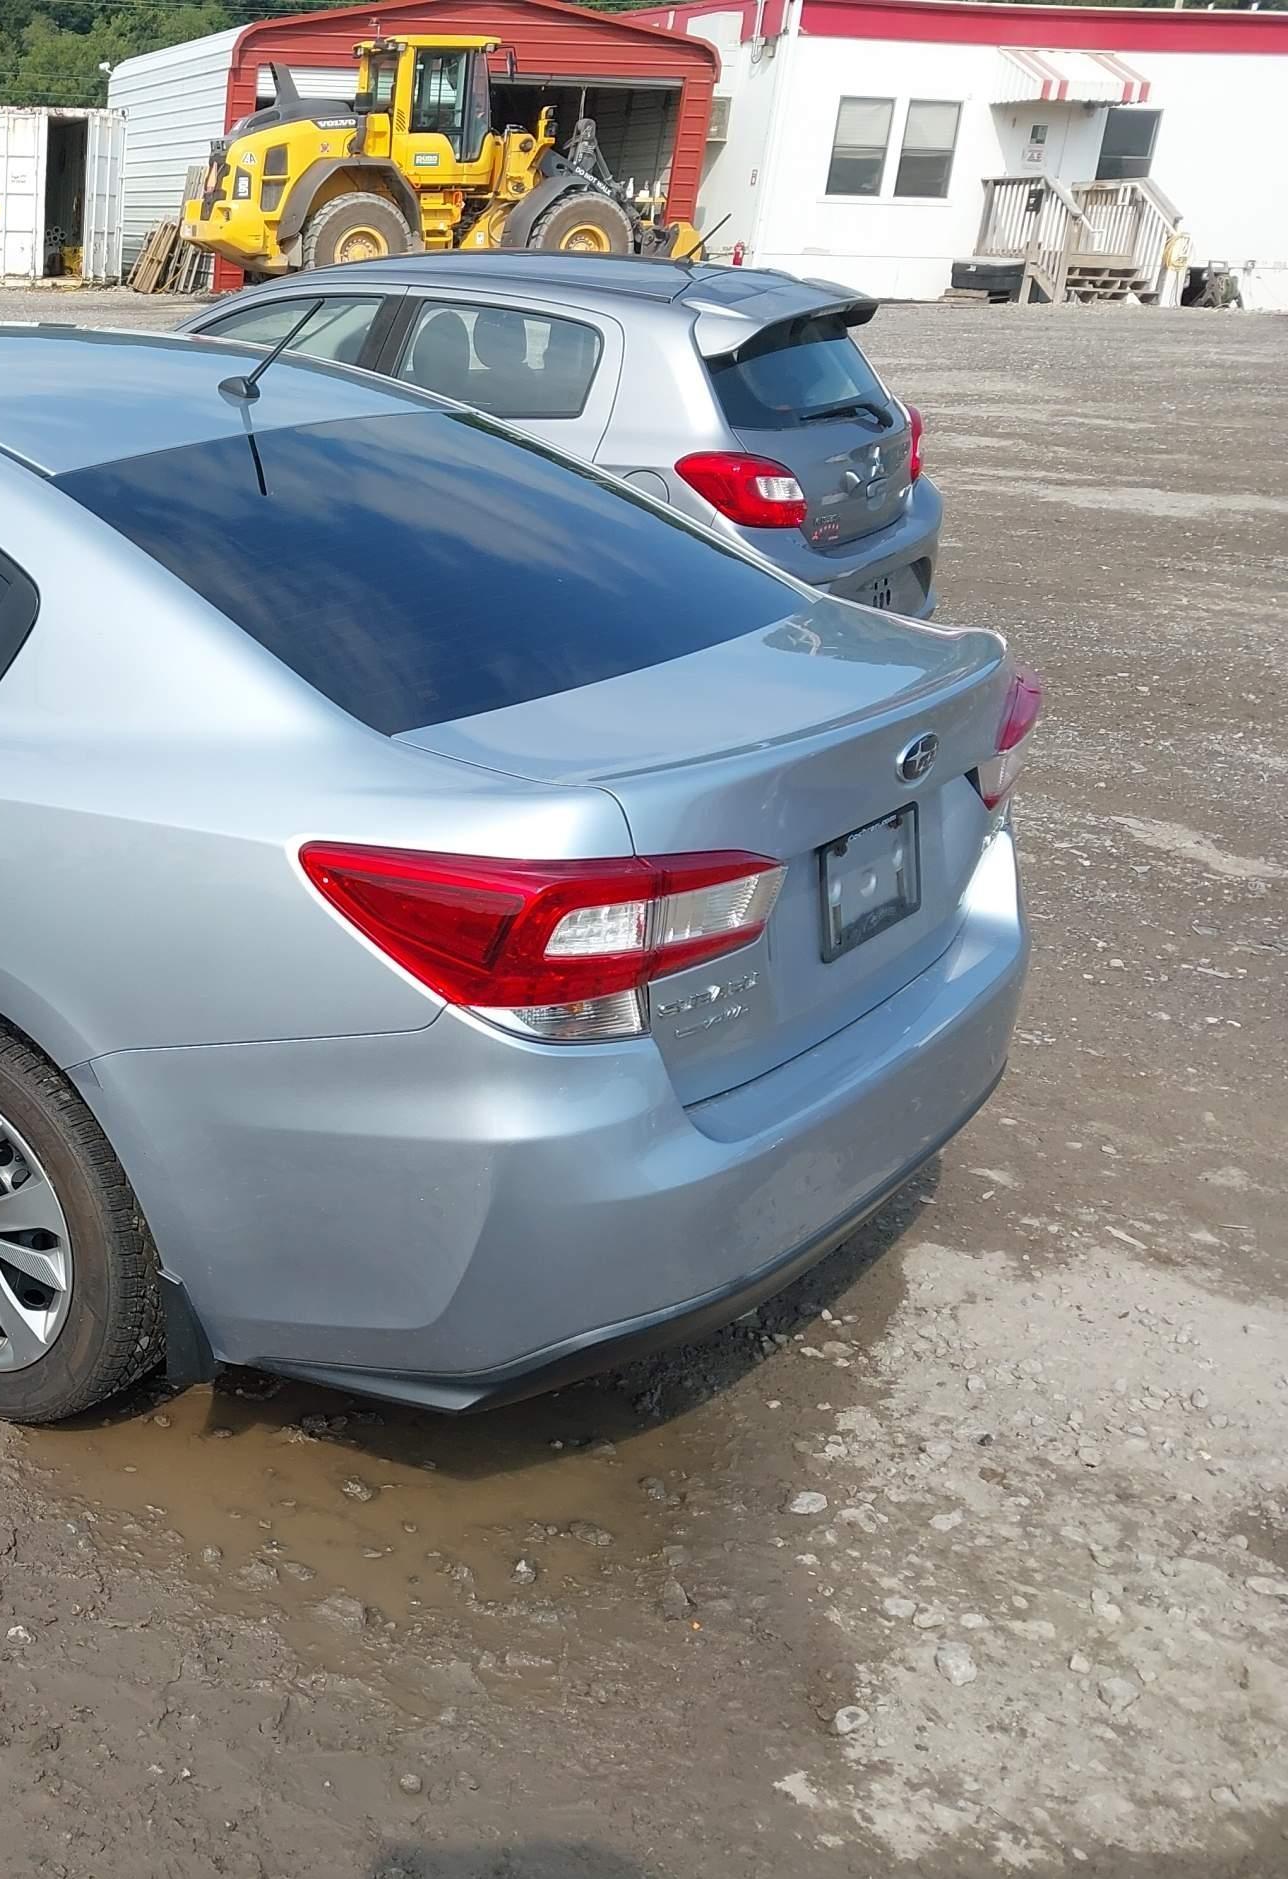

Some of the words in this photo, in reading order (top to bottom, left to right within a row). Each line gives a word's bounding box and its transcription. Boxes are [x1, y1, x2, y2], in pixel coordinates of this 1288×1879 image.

[317, 119, 356, 127] VOLVO
[575, 166, 585, 176] DO
[584, 172, 597, 183] NOT
